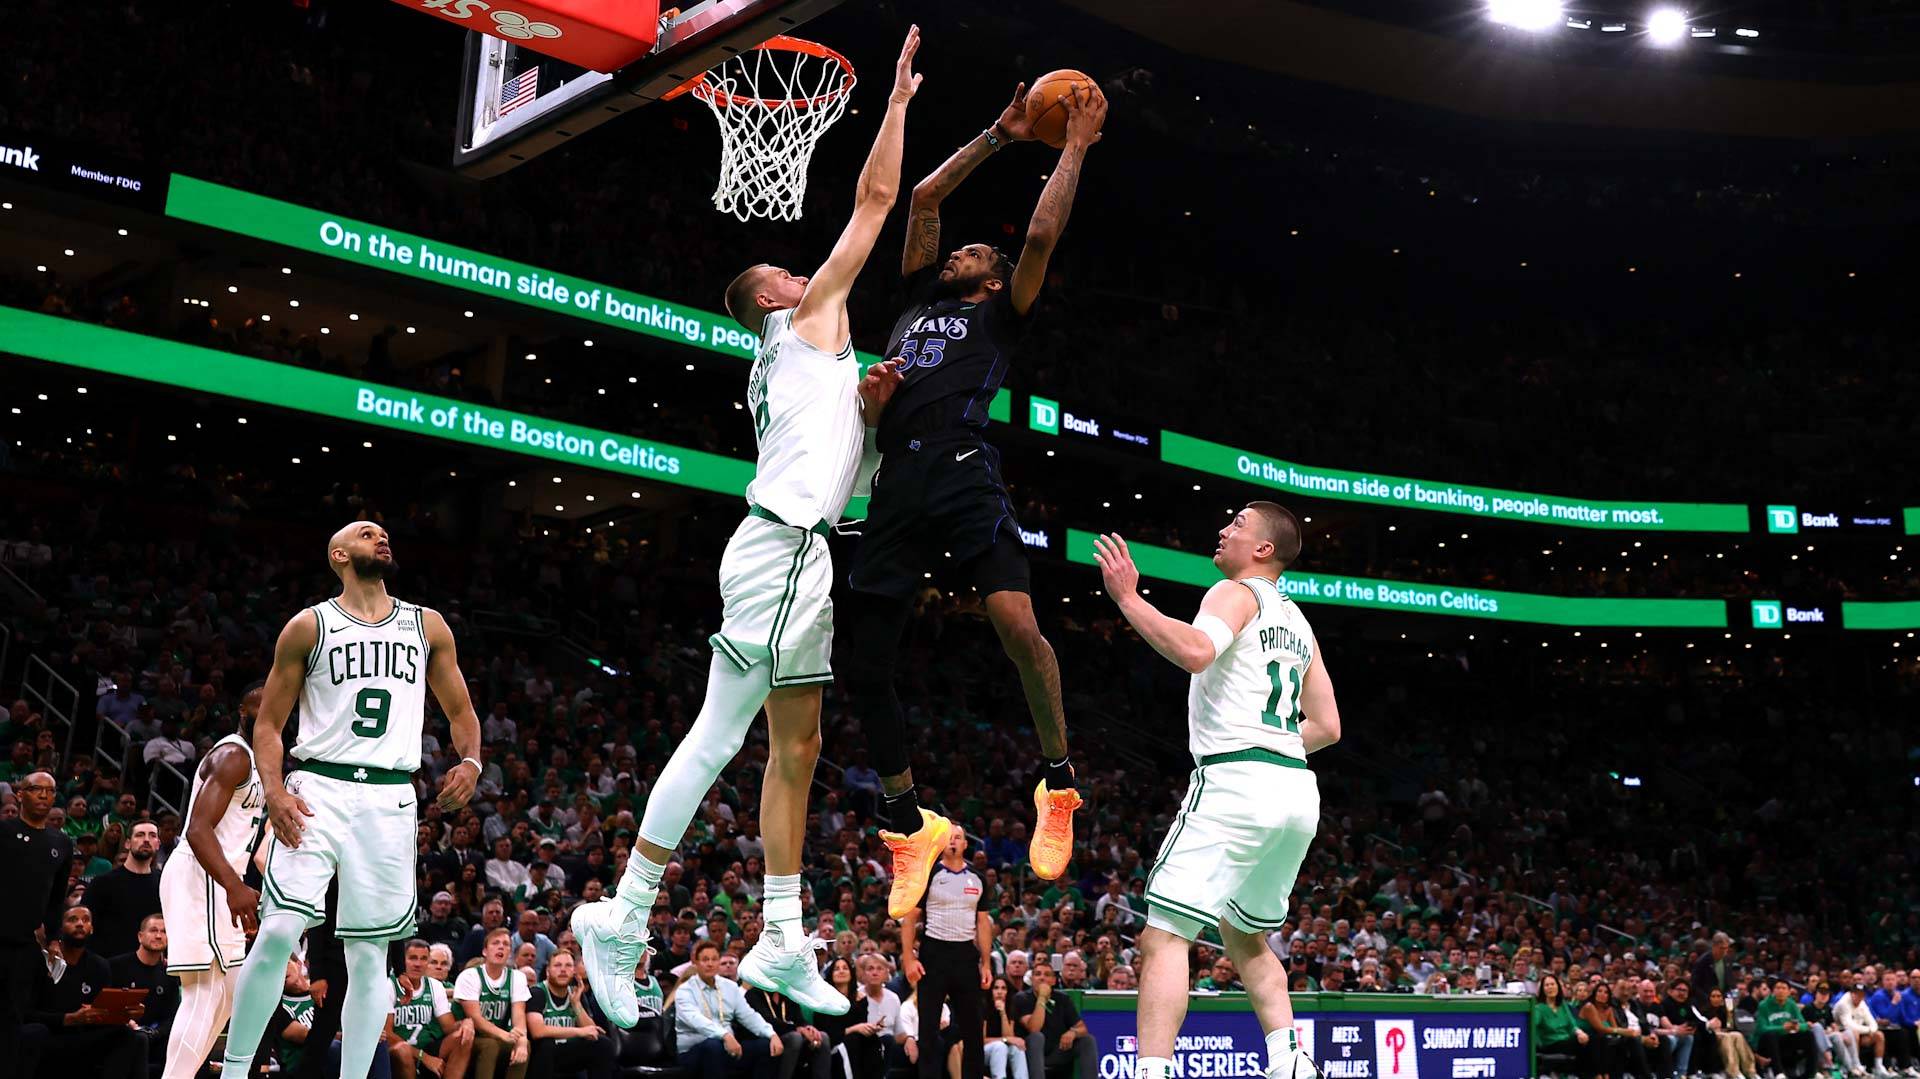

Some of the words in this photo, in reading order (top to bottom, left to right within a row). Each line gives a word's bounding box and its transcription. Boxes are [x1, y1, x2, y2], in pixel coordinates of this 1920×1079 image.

[0, 146, 40, 171] nk
[71, 165, 114, 184] Member
[116, 176, 141, 191] FDIC
[319, 221, 361, 252] On
[368, 234, 413, 264] the
[419, 245, 511, 289] human
[516, 273, 569, 303] side
[574, 289, 601, 311] of
[604, 293, 706, 341] banking,
[895, 338, 946, 372] 55
[357, 388, 424, 423] Bank
[430, 406, 458, 429] of
[463, 411, 505, 439] the
[510, 420, 595, 457] Boston
[599, 439, 680, 474] Celtics
[1032, 402, 1057, 427] TD
[1063, 412, 1099, 436] Bank
[1237, 455, 1260, 477] On
[1262, 462, 1287, 483] the
[1289, 468, 1349, 493] human
[1352, 478, 1390, 498] side
[1393, 483, 1412, 500] of
[1414, 484, 1489, 512] banking,
[1492, 497, 1549, 517] people
[1551, 504, 1608, 522] matter
[1612, 508, 1664, 523] most.
[1770, 509, 1796, 529] TD
[1801, 512, 1839, 527] Bank
[1276, 576, 1320, 596] Bank
[1323, 580, 1342, 598] of
[1345, 582, 1374, 601] the
[1377, 585, 1437, 606] Boston
[1440, 591, 1498, 612] Celtics
[1754, 605, 1780, 624] TD
[1786, 607, 1824, 622] Bank
[329, 641, 419, 686] CELTICS
[1261, 659, 1300, 735] 11
[351, 687, 392, 739] 9
[394, 1004, 432, 1027] BOSTON
[406, 1024, 423, 1045] 7
[1174, 1036, 1203, 1050] ORLD
[1204, 1036, 1233, 1050] TOUR
[1422, 1027, 1472, 1050] SUNDAY
[1472, 1027, 1486, 1049] 10
[1486, 1027, 1506, 1049] AM
[1506, 1027, 1521, 1049] ET
[1187, 1052, 1262, 1078] SERIES
[1452, 1057, 1496, 1078] ESPN
